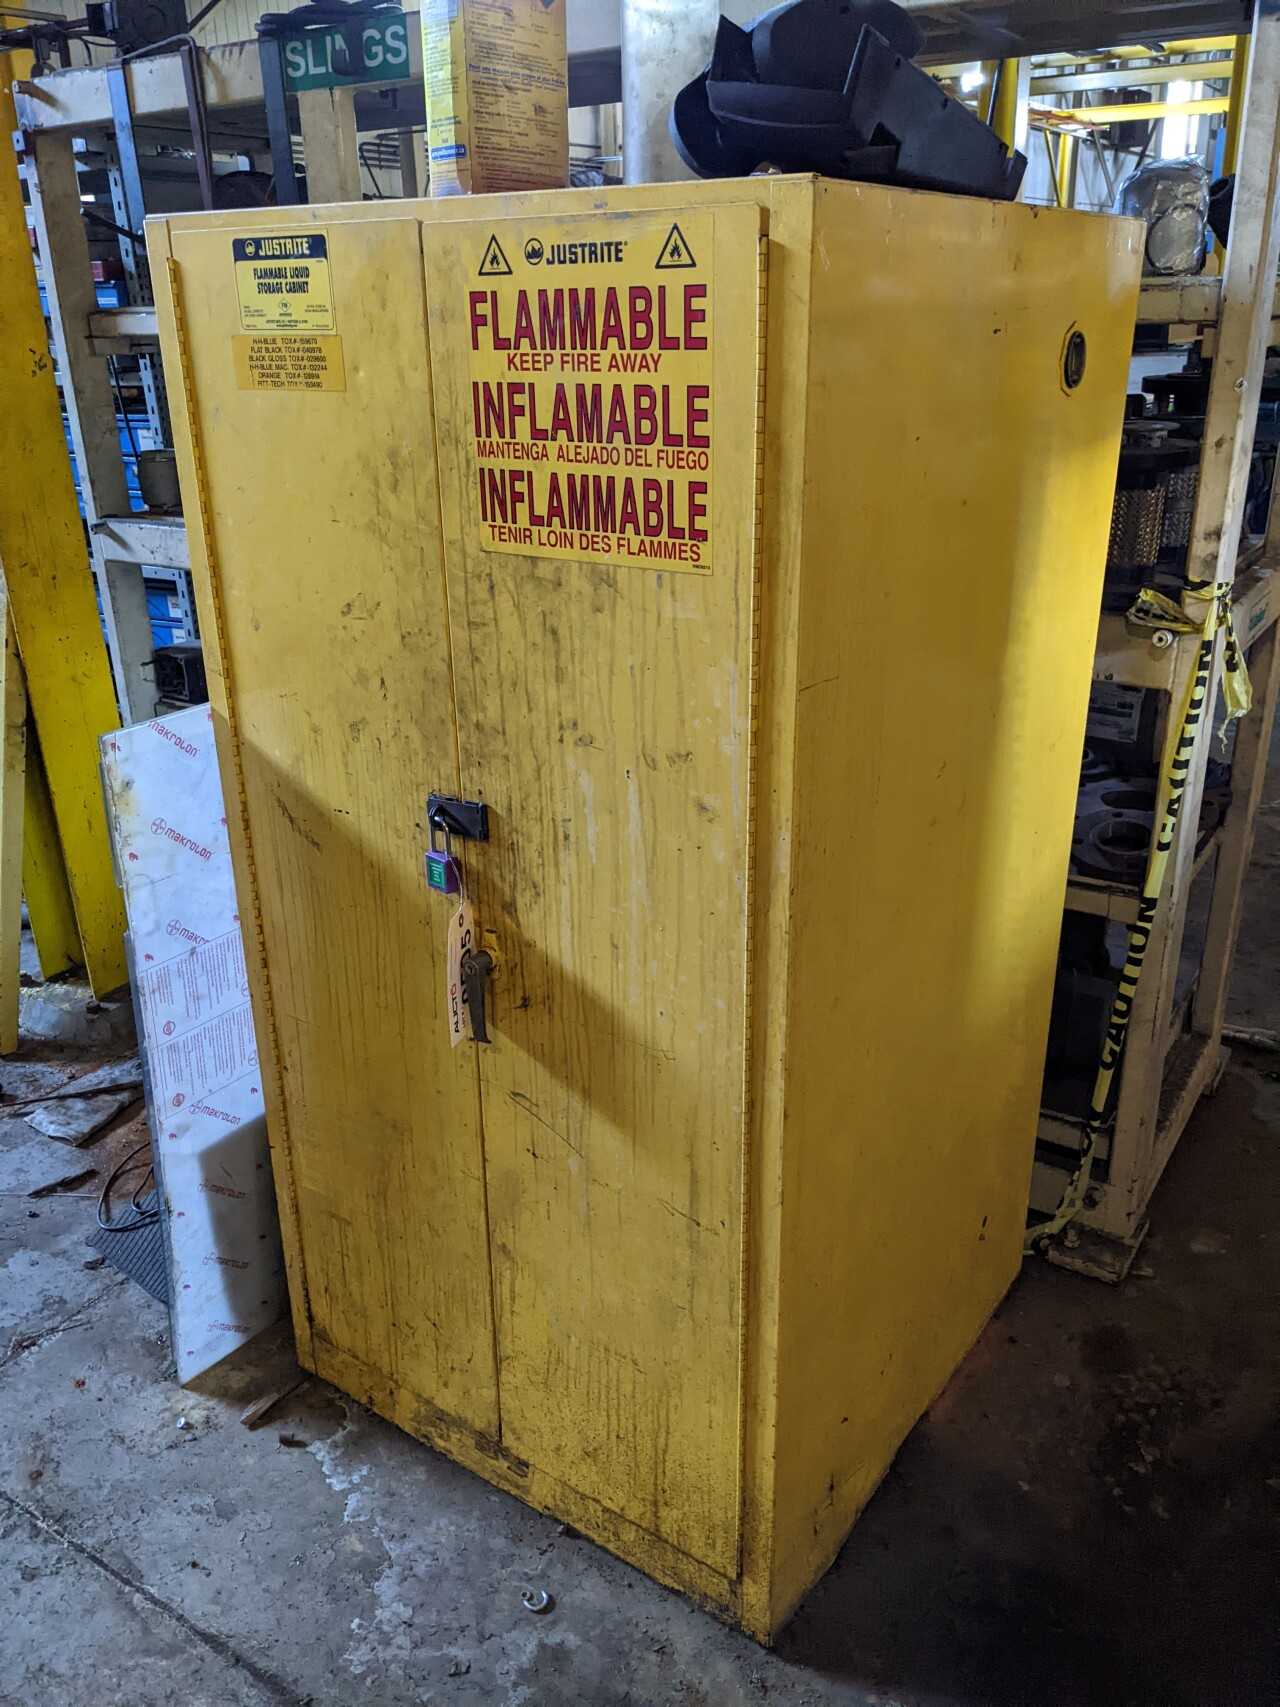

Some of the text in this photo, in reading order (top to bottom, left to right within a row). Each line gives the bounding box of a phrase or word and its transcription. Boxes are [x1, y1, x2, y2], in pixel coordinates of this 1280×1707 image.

[253, 266, 310, 280] FLAMMABLE LIQUID
[257, 281, 309, 294] STORAGE CABINET
[469, 284, 708, 351] FLAMMABLE
[264, 346, 282, 354] BLACK
[506, 353, 662, 373] KEEP FIRE AWAY
[472, 381, 710, 448] INFLAMABLE
[477, 440, 709, 470] MANTENGA ALEJADO DEL FUEGO
[479, 467, 708, 542] INFLAMMABLE
[488, 524, 701, 562] TENIR LOIN DES FLAMMES
[165, 826, 213, 861] makrolon
